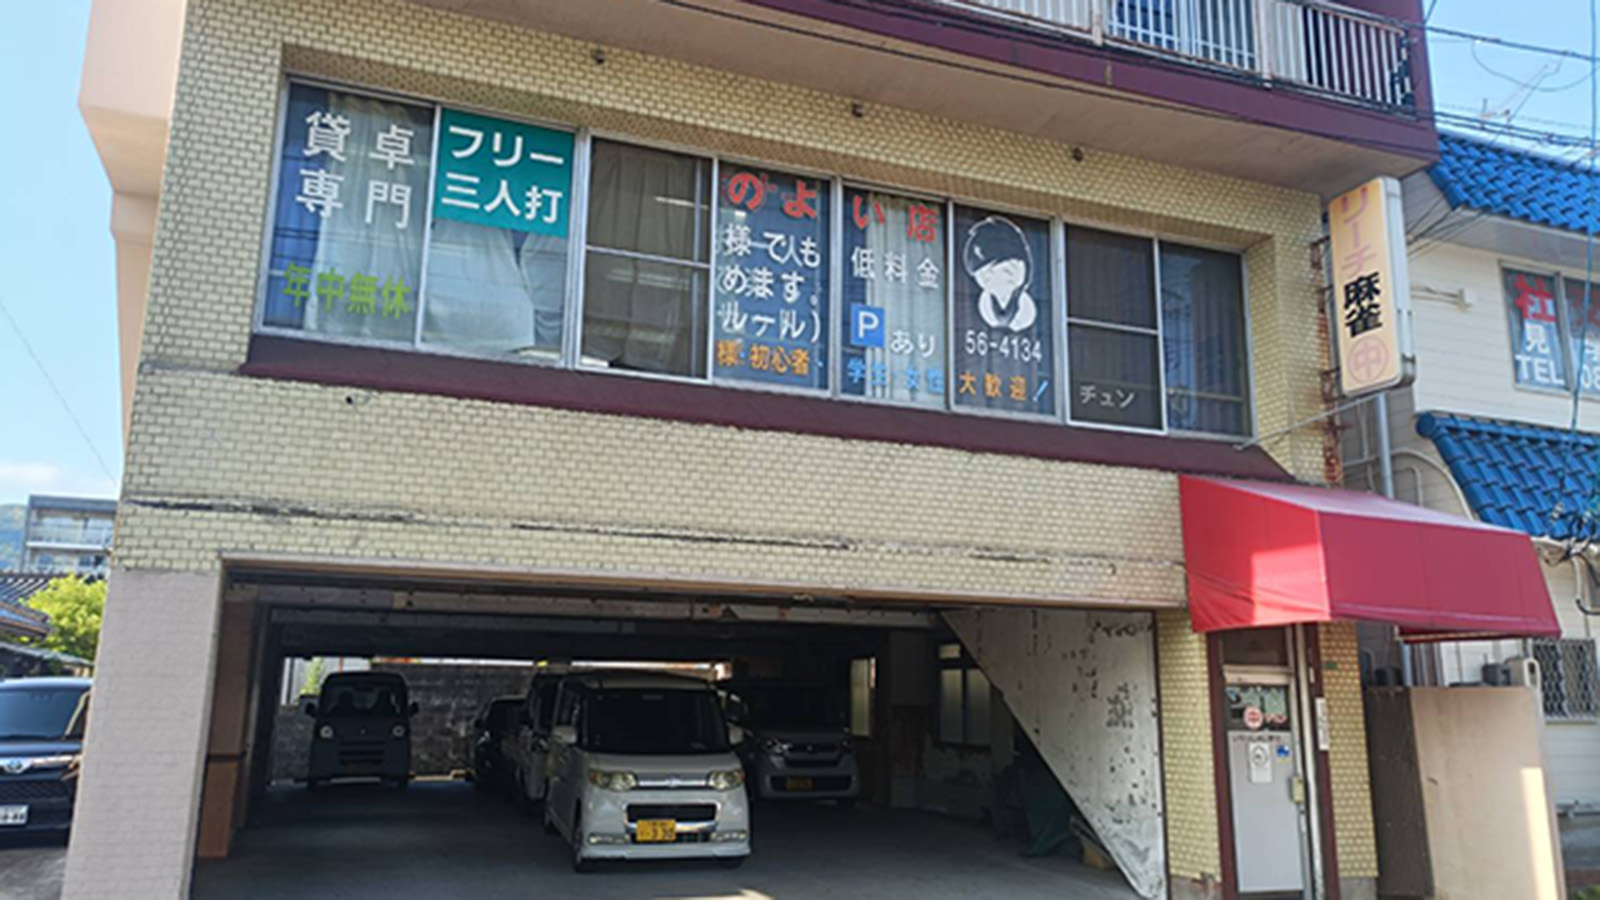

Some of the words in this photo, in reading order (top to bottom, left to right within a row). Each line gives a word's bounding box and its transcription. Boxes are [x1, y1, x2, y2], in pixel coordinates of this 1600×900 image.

[449, 126, 564, 167] フリー
[441, 172, 563, 223] 三人打
[852, 246, 940, 291] 低料金
[281, 262, 412, 319] 年中無休
[858, 311, 879, 338] P
[890, 331, 935, 358] あり
[965, 329, 1042, 363] 56-4134
[1515, 354, 1565, 386] TEL
[1079, 385, 1134, 408] チュン
